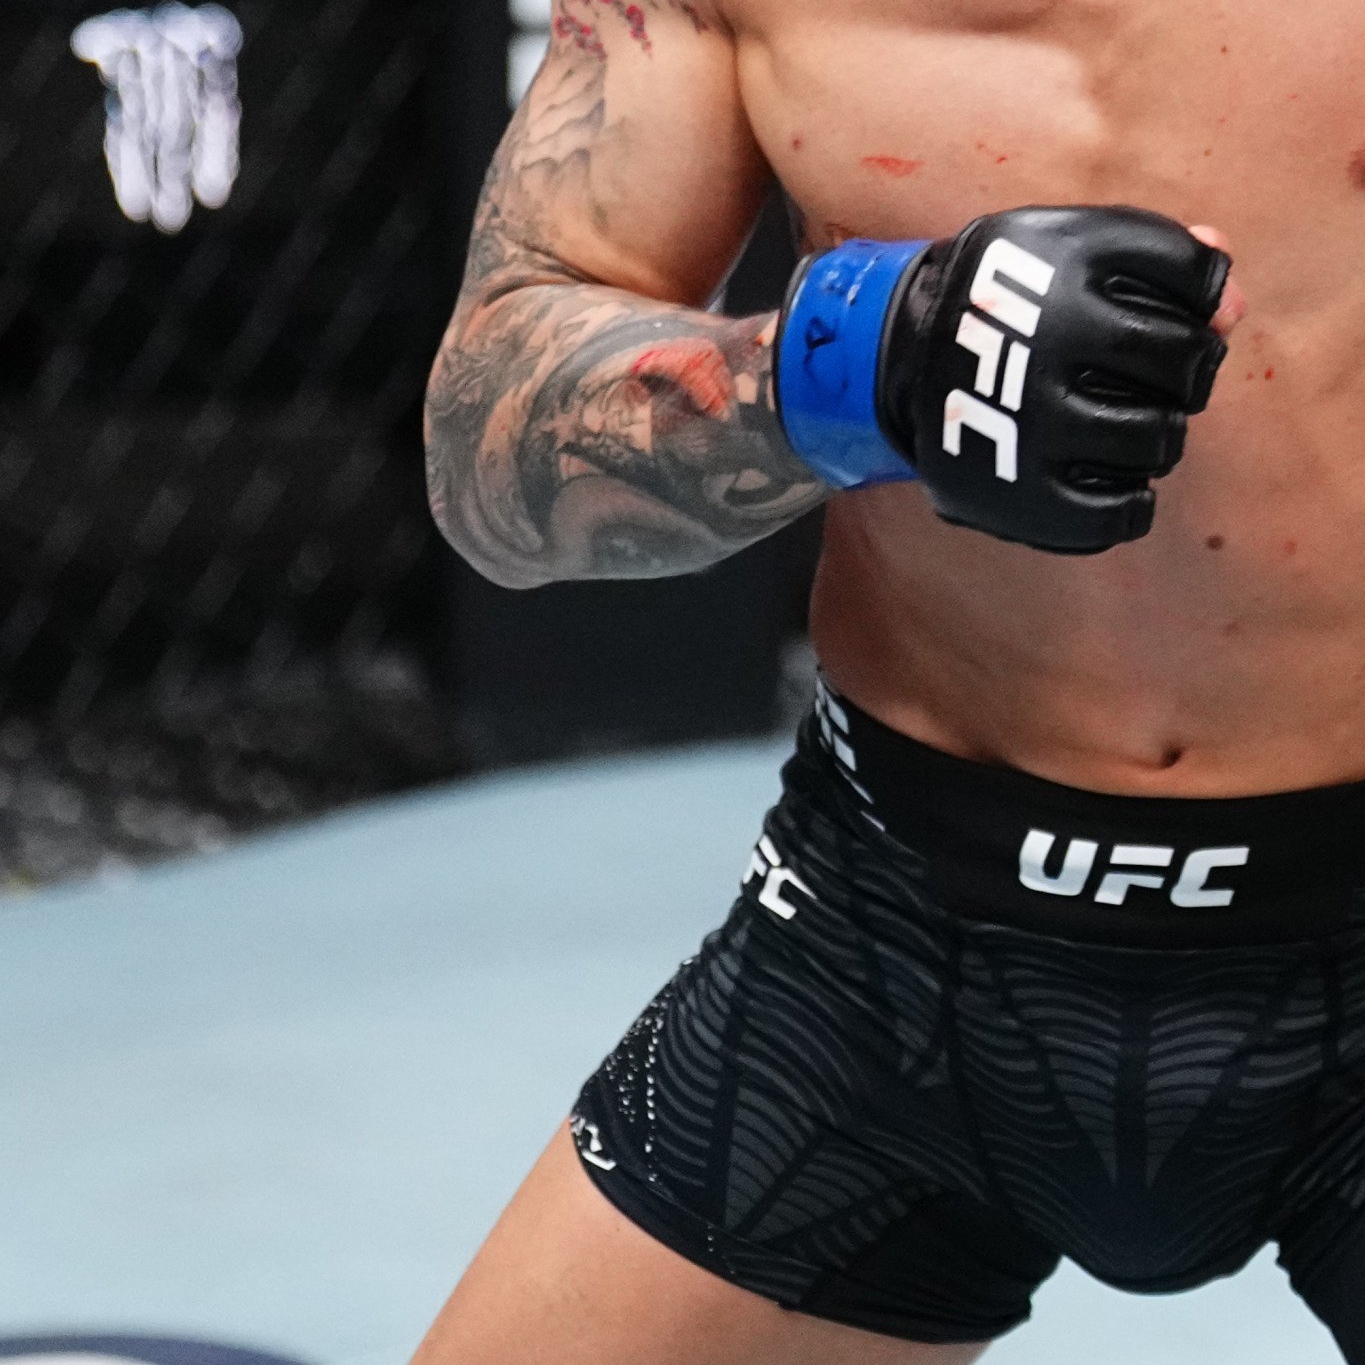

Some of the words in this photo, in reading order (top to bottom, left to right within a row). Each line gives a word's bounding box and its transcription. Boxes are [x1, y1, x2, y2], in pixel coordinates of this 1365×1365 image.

[942, 237, 1056, 483] UFC
[742, 834, 818, 920] FC
[1018, 828, 1250, 908] UFC
